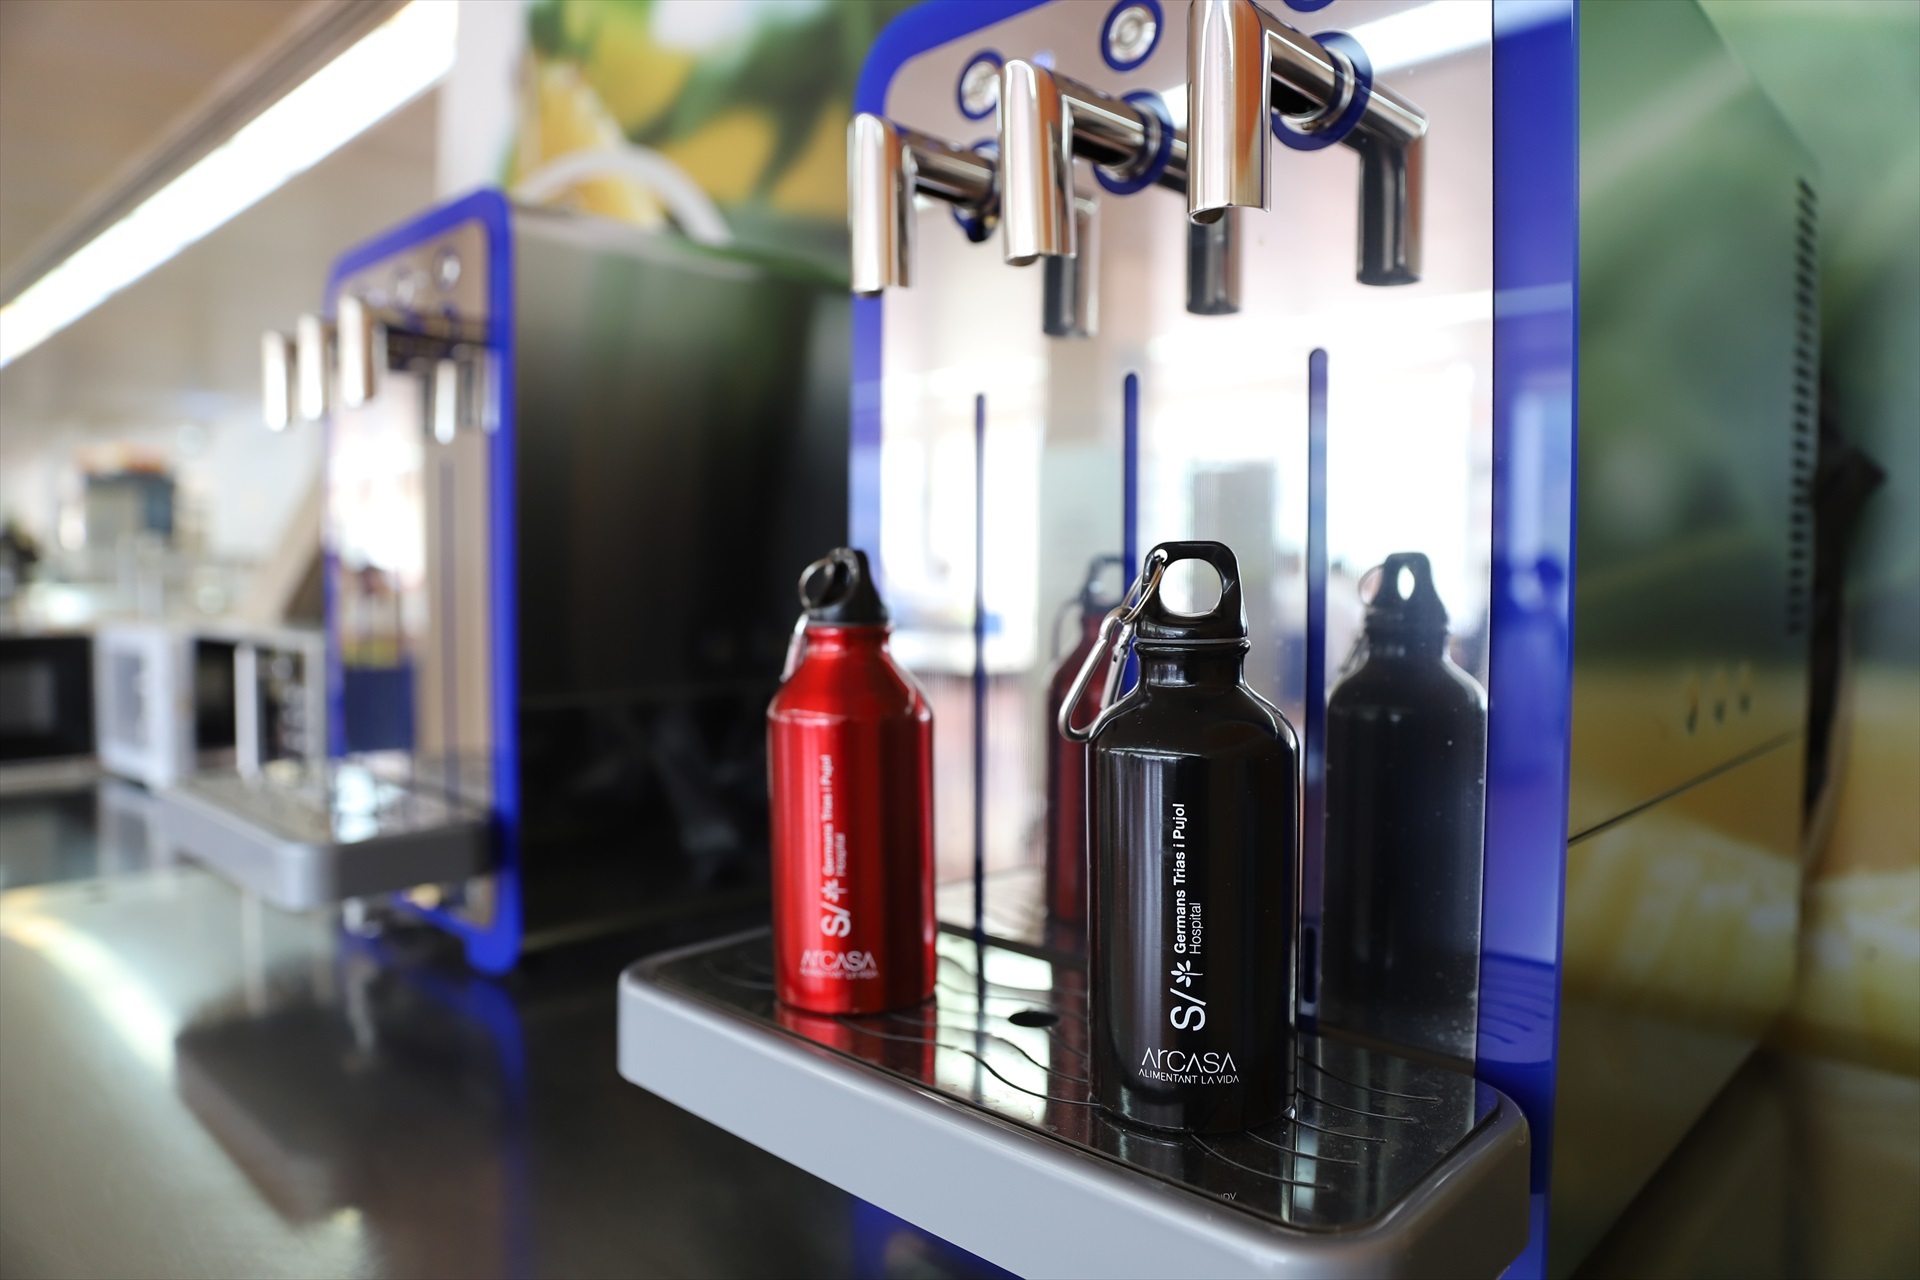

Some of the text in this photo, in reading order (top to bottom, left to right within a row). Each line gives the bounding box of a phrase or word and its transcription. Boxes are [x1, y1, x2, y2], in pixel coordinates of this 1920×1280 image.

[819, 754, 834, 786] Pujol
[821, 793, 834, 821] Trias
[1172, 803, 1188, 840] Pujol
[822, 823, 835, 876] Germans
[1173, 851, 1186, 886] Trias
[1173, 889, 1187, 954] Germans
[1189, 902, 1202, 955] Hospital
[1139, 1068, 1240, 1085] ALIMENTANT LA VIDA
